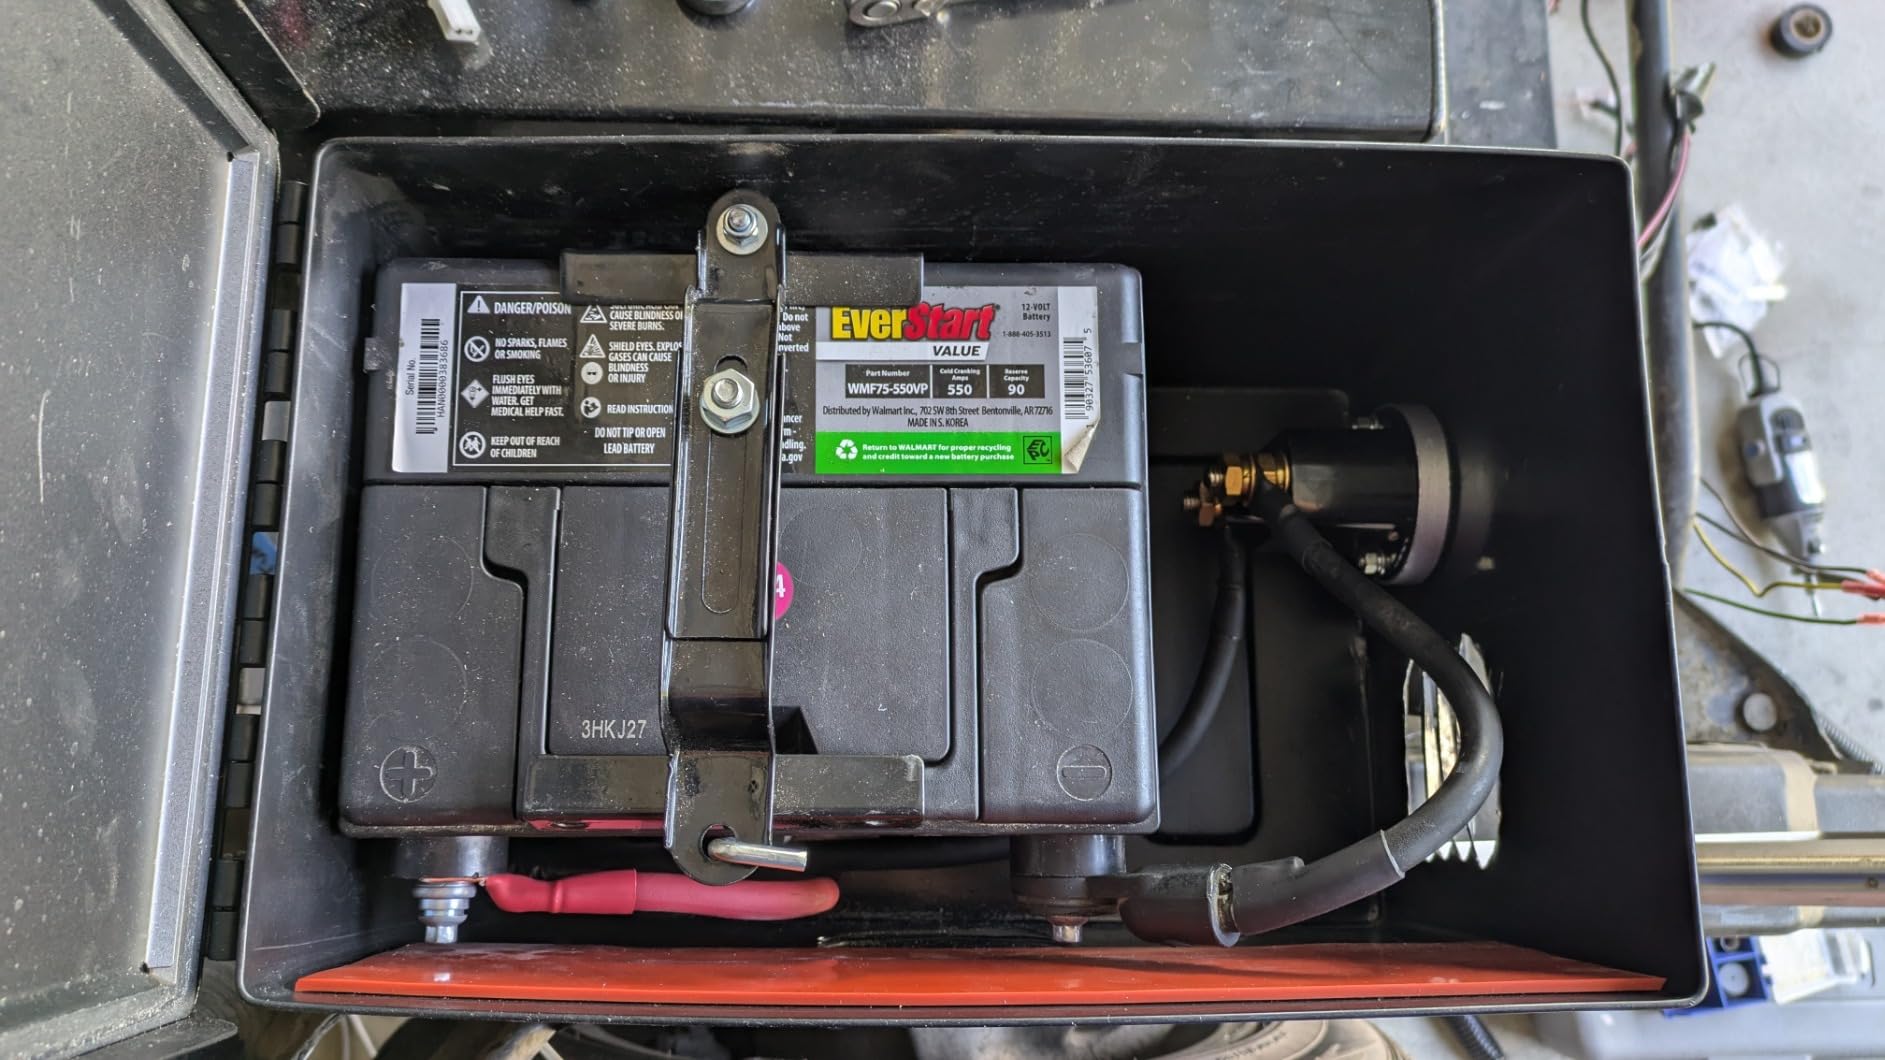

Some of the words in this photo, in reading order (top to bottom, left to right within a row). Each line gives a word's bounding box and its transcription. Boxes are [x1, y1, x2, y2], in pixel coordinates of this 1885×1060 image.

[494, 302, 572, 315] DANGER/POISON
[1021, 303, 1051, 311] 12-VOLT
[610, 310, 633, 320] CAUSE
[634, 310, 674, 320] BLINDNESS
[782, 312, 793, 321] Do
[795, 313, 809, 321] not
[1022, 313, 1051, 321] Battery
[609, 321, 636, 331] SEVERE
[637, 321, 665, 331] BURNS.
[831, 301, 995, 341] EverStart
[778, 332, 793, 342] Not
[495, 338, 506, 348] NO
[507, 338, 537, 349] SPARKS,
[538, 338, 567, 348] FLAMES
[608, 341, 635, 351] SHIELD
[636, 341, 656, 351] EYES.
[494, 350, 506, 359] OR
[506, 350, 541, 359] SMOKING
[933, 345, 981, 357] VALUE
[608, 352, 632, 362] GASES
[632, 352, 648, 362] CAN
[649, 352, 672, 362] CAUSE
[1083, 345, 1093, 375] 53607
[608, 363, 649, 372] BLINDNESS
[437, 340, 449, 418] HAN0000383686
[492, 374, 516, 385] FLUSH
[516, 374, 536, 385] EYES
[608, 373, 619, 383] OR
[619, 373, 646, 383] INJURY
[405, 373, 416, 396] Serial
[847, 383, 929, 395] WMF75-550VP
[491, 385, 541, 395] IMMEDIATELY
[541, 385, 562, 395] WITH
[947, 384, 973, 396] 550
[1007, 384, 1025, 396] 90
[491, 396, 520, 406] WATER.
[520, 396, 535, 406] GET
[1084, 381, 1094, 411] 90327
[491, 406, 524, 417] MEDICAL
[524, 406, 544, 417] HELP
[544, 406, 565, 417] FAST.
[607, 404, 627, 414] READ
[823, 406, 861, 415] Distributed
[862, 406, 871, 417] by
[872, 406, 903, 415] Walmart
[903, 406, 918, 416] Inc.,
[920, 406, 932, 415] 702
[933, 406, 945, 415] SW
[945, 406, 958, 415] 8th
[959, 406, 979, 415] Street
[982, 406, 1024, 416] Bentonville,
[1024, 406, 1035, 415] AR
[1035, 406, 1053, 415] 72716
[907, 418, 928, 427] MADE
[929, 418, 938, 427] IN
[938, 418, 945, 427] S.
[946, 418, 968, 427] KOREA
[594, 427, 605, 438] DO
[606, 427, 621, 438] NOT
[622, 427, 634, 438] TIP
[635, 427, 646, 438] OR
[646, 427, 666, 438] OPEN
[490, 436, 509, 446] KEEP
[510, 436, 525, 446] OUT
[525, 436, 536, 446] OF
[536, 436, 560, 446] REACH
[603, 443, 622, 454] LEAD
[623, 443, 655, 454] BATTERY
[977, 444, 1012, 452] recycling
[490, 449, 500, 458] OF
[501, 449, 537, 458] CHILDREN
[951, 453, 979, 461] battery
[980, 453, 1014, 461] purchase
[581, 719, 647, 739] 3HKJ27
